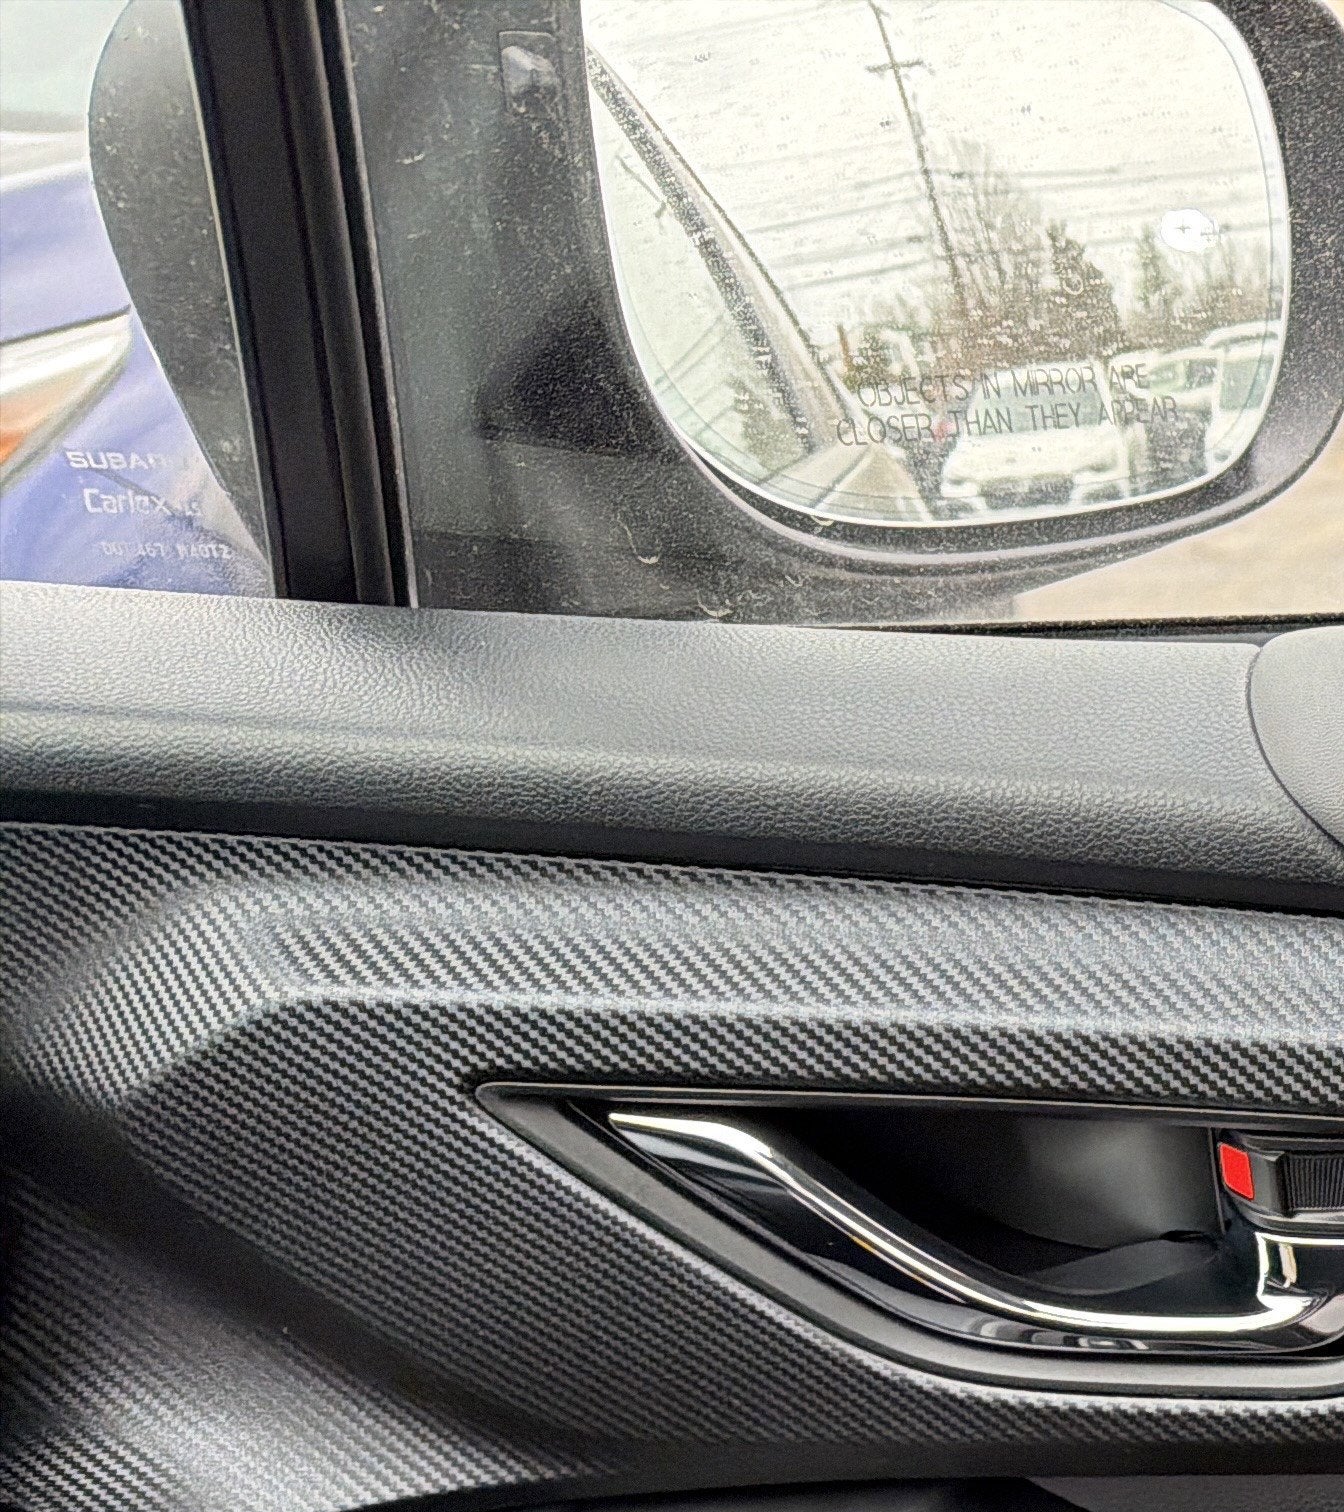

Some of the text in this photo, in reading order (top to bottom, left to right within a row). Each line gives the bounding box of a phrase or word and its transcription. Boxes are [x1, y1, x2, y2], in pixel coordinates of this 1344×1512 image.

[858, 362, 1149, 407] OBJECTS IN MIRROR ARE
[836, 395, 1179, 447] CLOSER THAN THEY APPEAR
